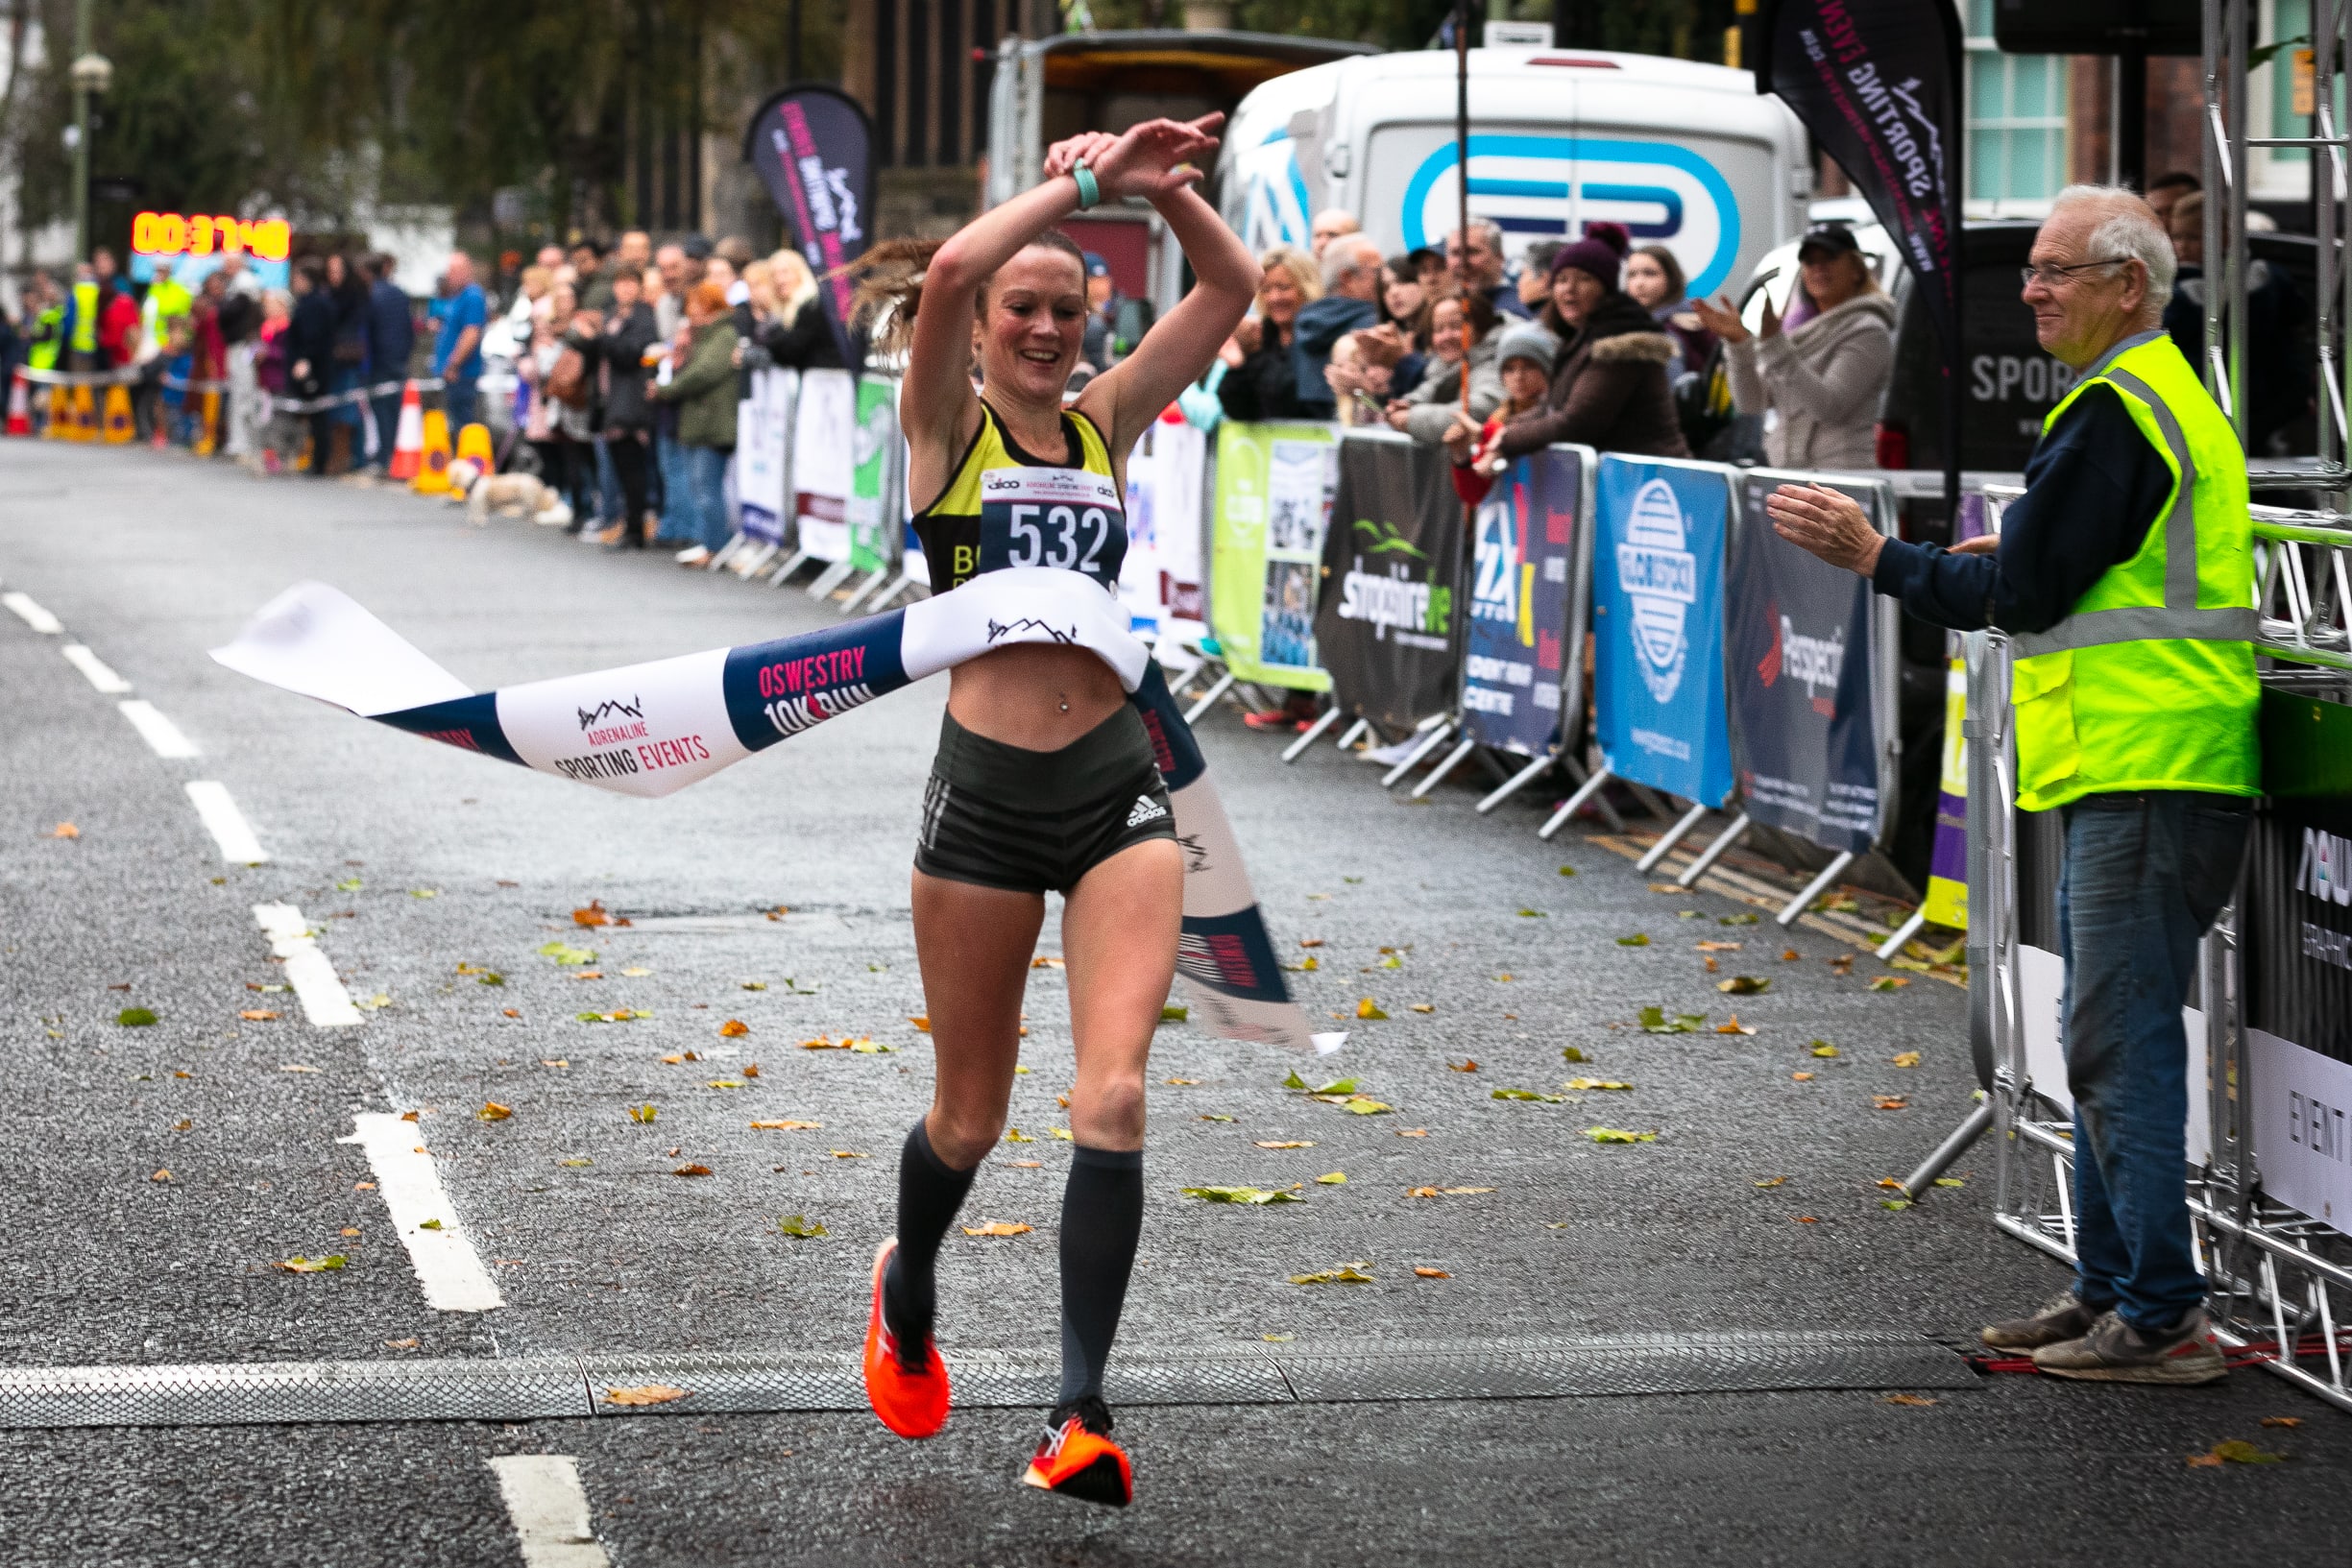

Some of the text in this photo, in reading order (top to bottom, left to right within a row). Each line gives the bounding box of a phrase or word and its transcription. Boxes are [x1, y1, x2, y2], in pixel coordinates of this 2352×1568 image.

[1008, 504, 1108, 572] 532
[759, 645, 866, 698] OSWESTRY
[588, 722, 649, 747] ADRENALINE
[764, 688, 826, 736] 10K
[554, 735, 710, 781] SPORTING EVENTS
[1127, 807, 1167, 827] adidas
